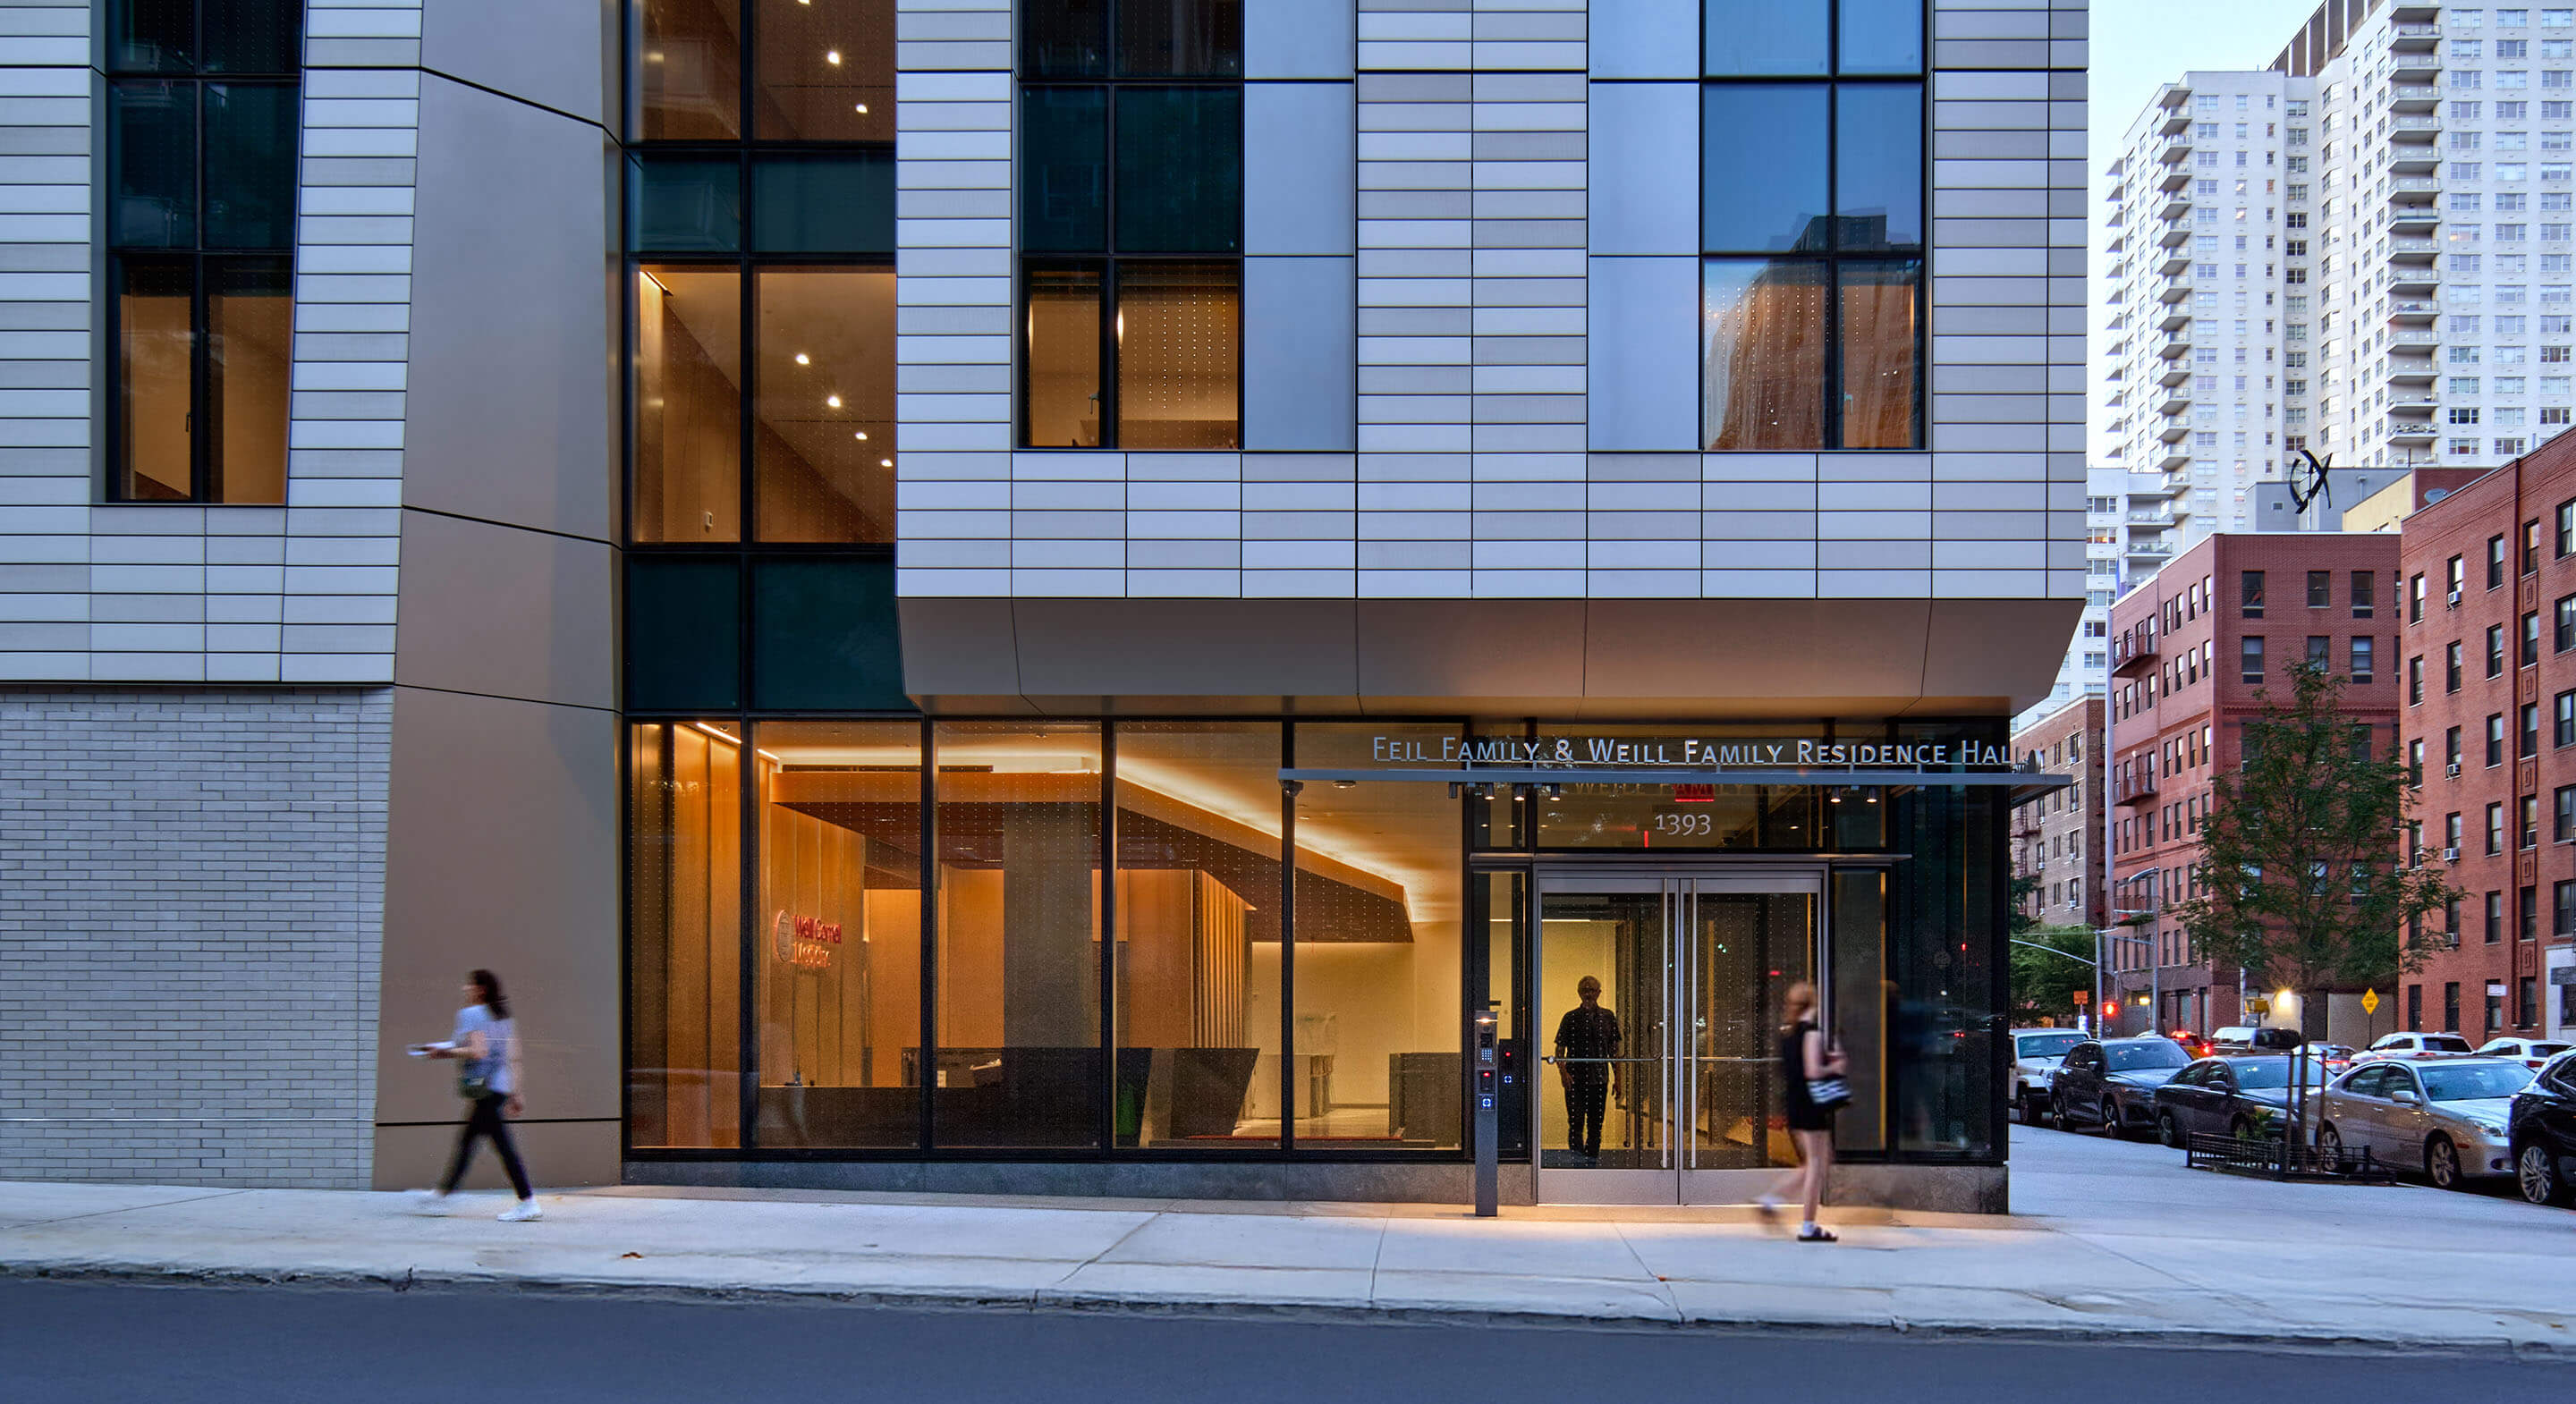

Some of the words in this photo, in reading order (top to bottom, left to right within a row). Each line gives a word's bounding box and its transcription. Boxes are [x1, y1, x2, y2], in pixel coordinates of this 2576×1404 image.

[1373, 736, 1428, 760] FEIL
[1443, 736, 1540, 760] FAMILY
[1555, 739, 1574, 761] &
[1588, 738, 1671, 763] WEILL
[1684, 739, 1784, 764] FAMILY
[1796, 739, 1947, 764] RESIDENCE
[1654, 814, 1712, 836] 1393
